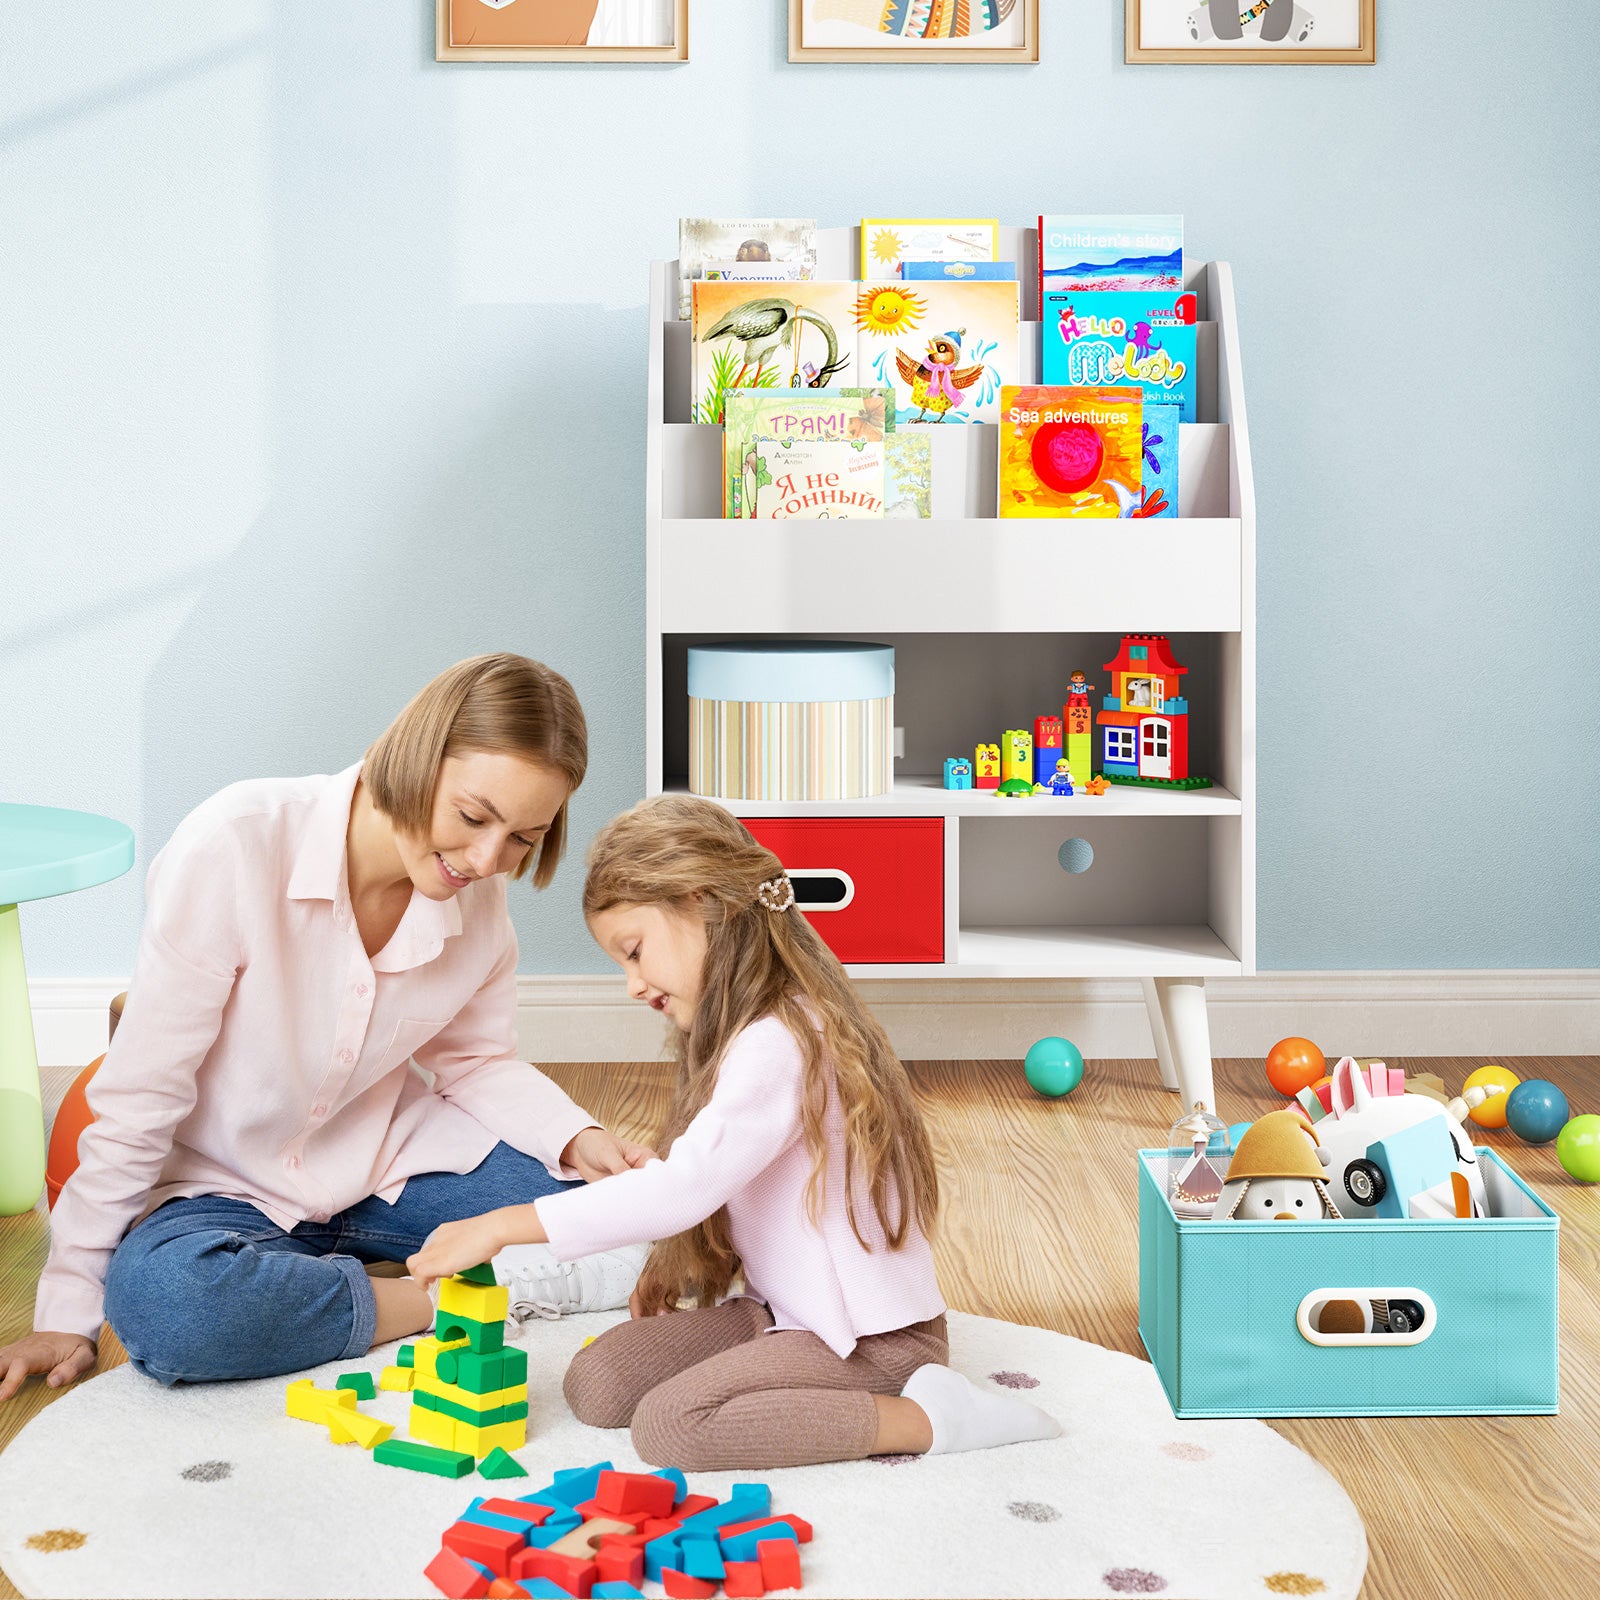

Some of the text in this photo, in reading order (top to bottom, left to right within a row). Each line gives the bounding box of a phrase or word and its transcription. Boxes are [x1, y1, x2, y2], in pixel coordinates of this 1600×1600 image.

[1050, 233, 1176, 250] Children's story
[1146, 303, 1185, 318] LEVEL 1
[1059, 318, 1125, 343] HELLO
[1142, 391, 1186, 403] glish Book
[1009, 407, 1129, 425] Sea adventures
[770, 413, 845, 435] ТРЯМ!
[776, 472, 840, 500] Я не
[1075, 720, 1085, 733] 5
[1046, 735, 1056, 747] 4
[1018, 750, 1027, 762] 3
[984, 764, 993, 775] 2
[955, 777, 962, 789] 1
